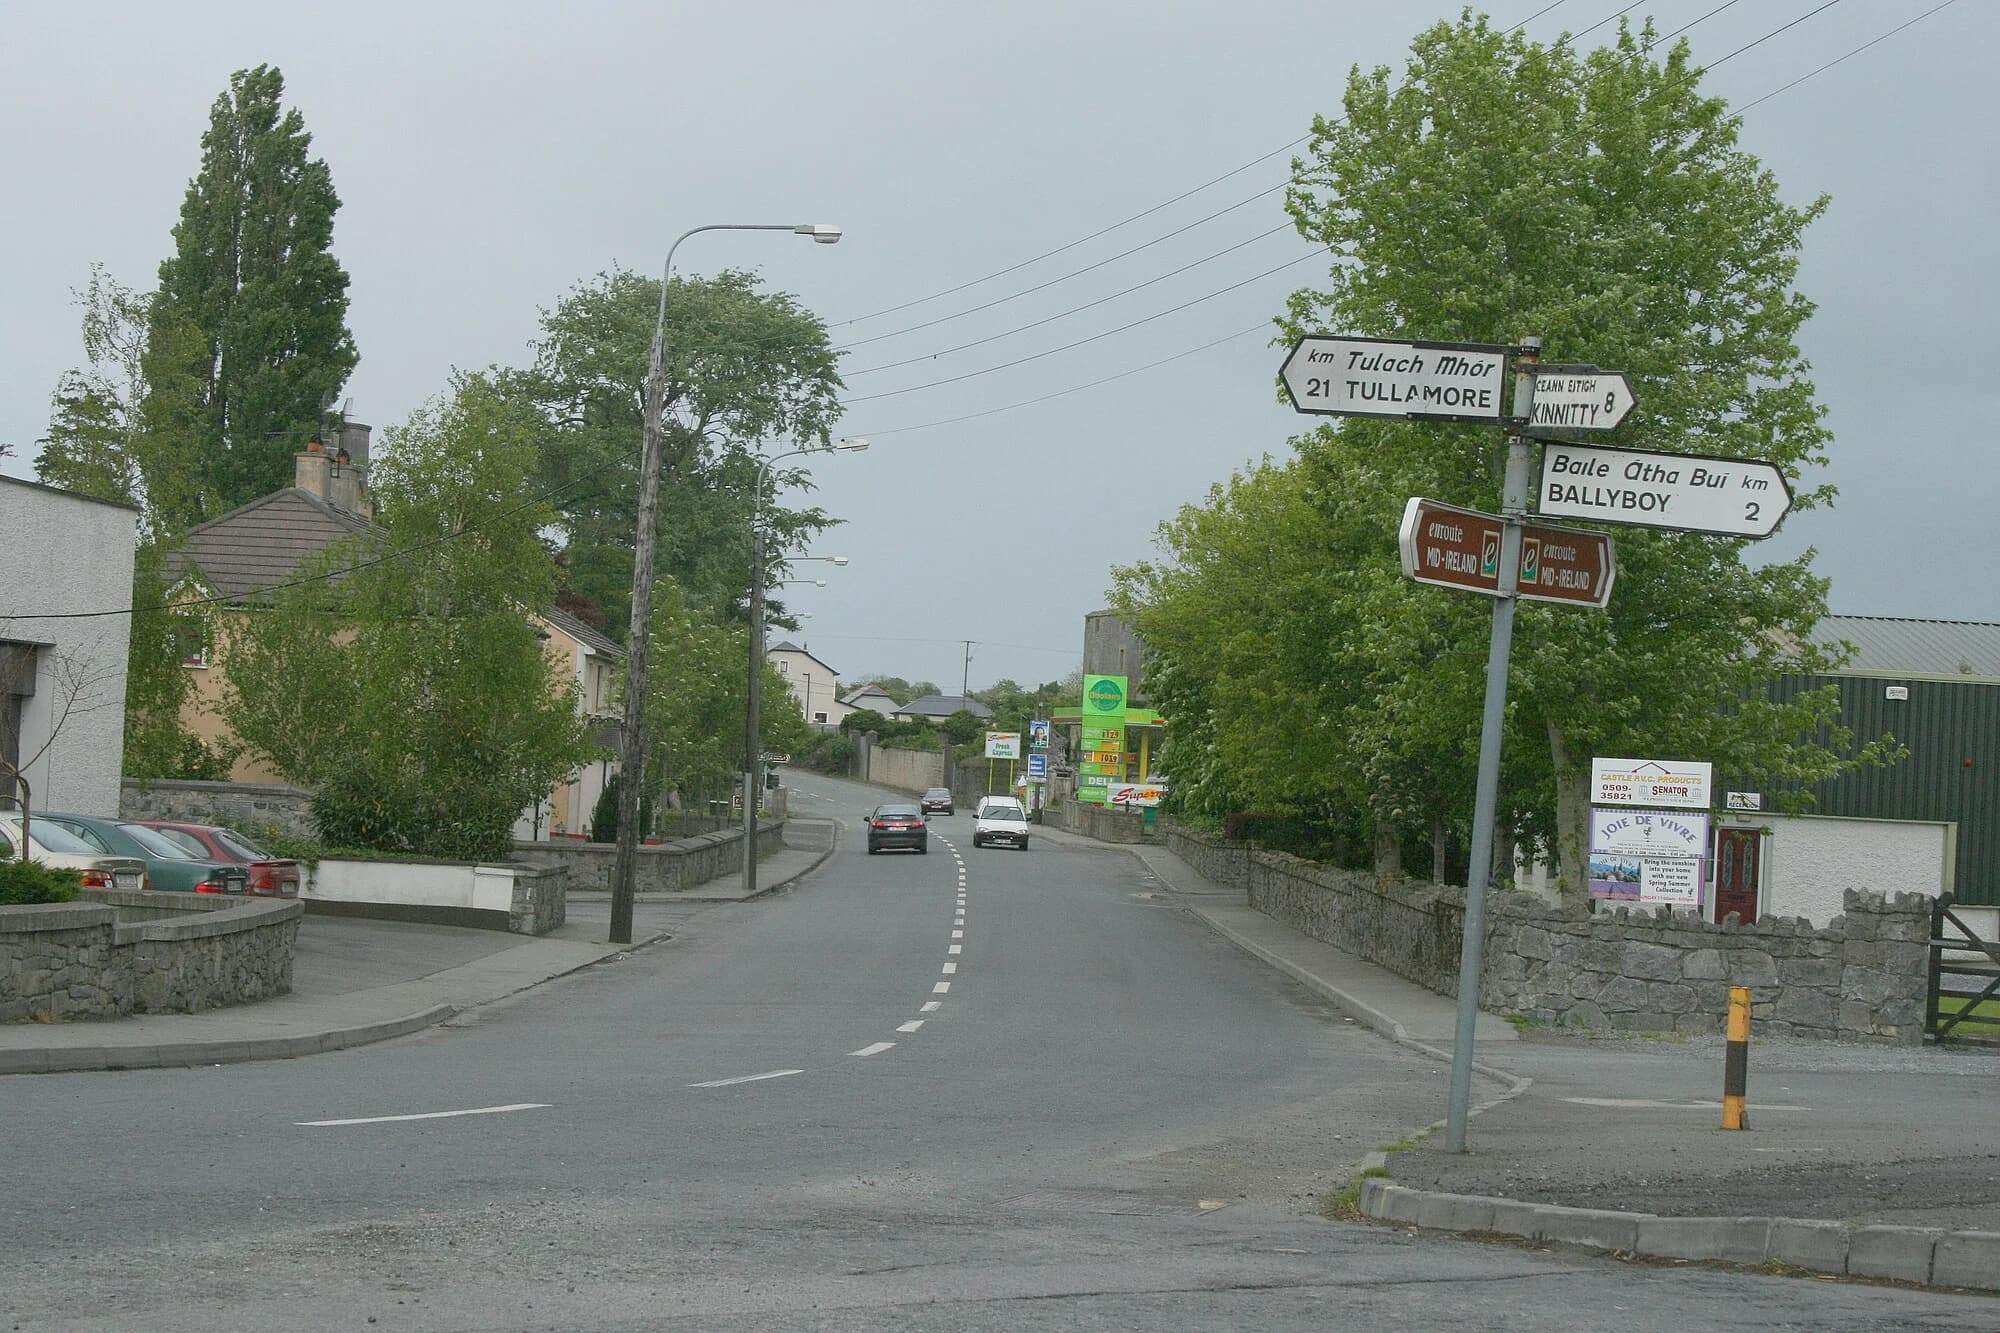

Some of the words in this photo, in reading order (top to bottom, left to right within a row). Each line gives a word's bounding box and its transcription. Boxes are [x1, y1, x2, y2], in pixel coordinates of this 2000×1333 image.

[1307, 349, 1334, 364] km
[1347, 351, 1423, 373] Tulach
[1434, 355, 1496, 378] Mhór
[1306, 378, 1330, 398] 21
[1346, 381, 1492, 409] TULLAMORE
[1536, 379, 1564, 392] CEANN
[1604, 391, 1615, 414] 8
[1531, 403, 1600, 425] KINNITTY
[1551, 454, 1610, 477] Baile
[1624, 459, 1680, 484] Átha
[1689, 468, 1730, 489] Buí
[1741, 474, 1768, 491] km
[1548, 483, 1672, 513] BALLYBOY
[1744, 502, 1760, 522] 2
[1428, 522, 1463, 544] enroute
[1543, 543, 1577, 562] enroute
[1600, 774, 1632, 782] CASTLE
[1657, 776, 1702, 785] PRODUCTS
[1600, 792, 1632, 800] 35821
[1652, 785, 1688, 798] SENATOR
[1601, 817, 1630, 840] JOIE
[1635, 815, 1653, 826] DE
[1660, 817, 1697, 844] VIVRE
